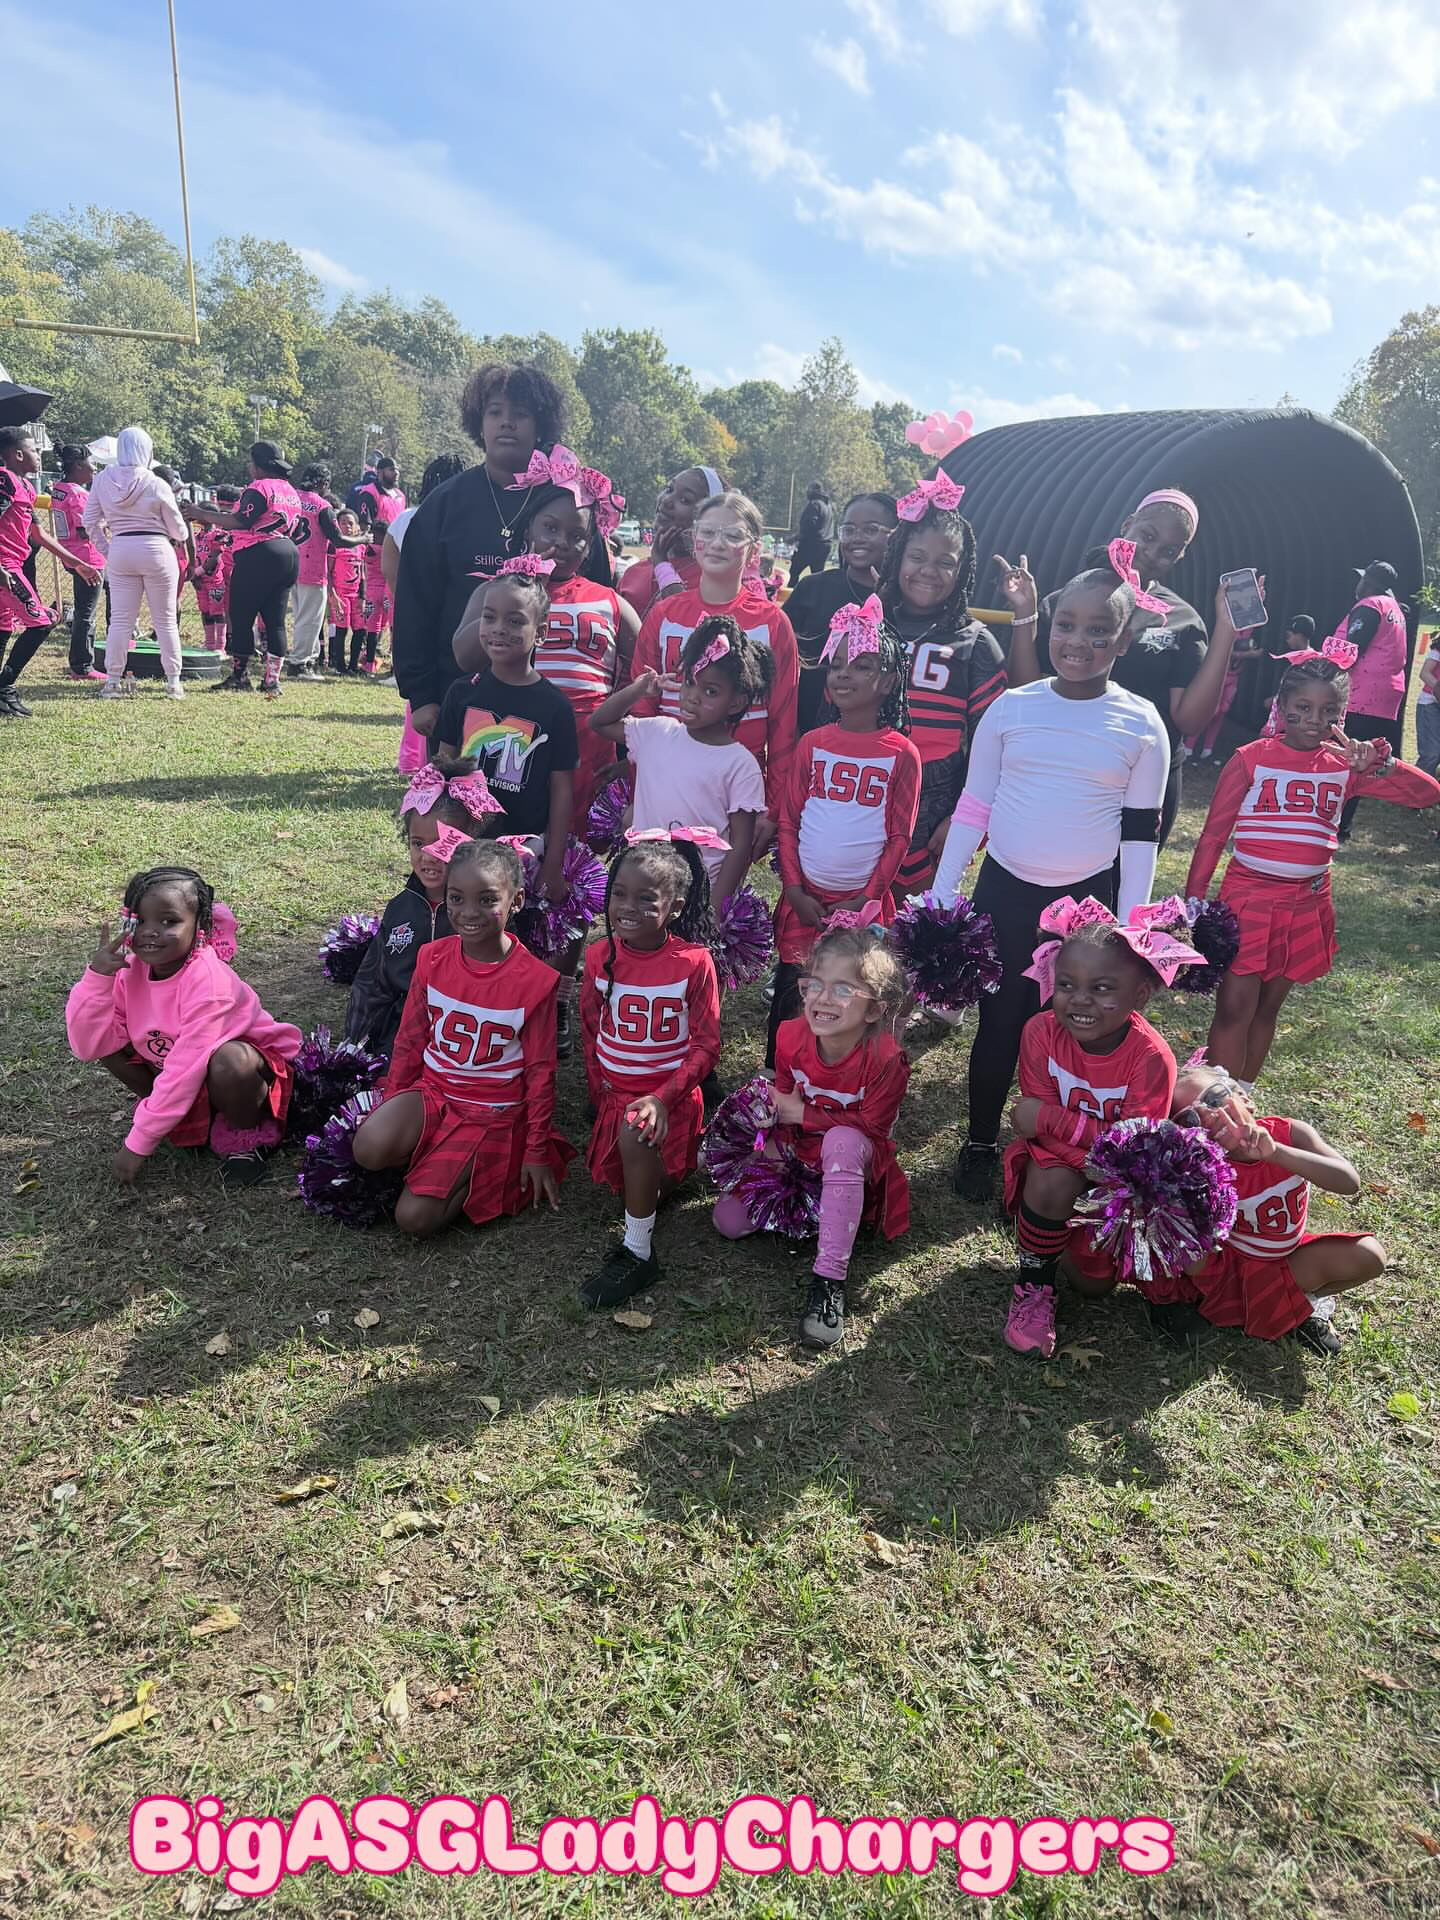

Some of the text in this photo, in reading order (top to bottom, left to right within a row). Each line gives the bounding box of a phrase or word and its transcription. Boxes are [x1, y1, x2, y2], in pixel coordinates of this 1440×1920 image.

[545, 611, 609, 661] SG
[487, 777, 522, 793] LEVISION
[809, 760, 890, 807] ASG
[1253, 779, 1343, 821] ASG
